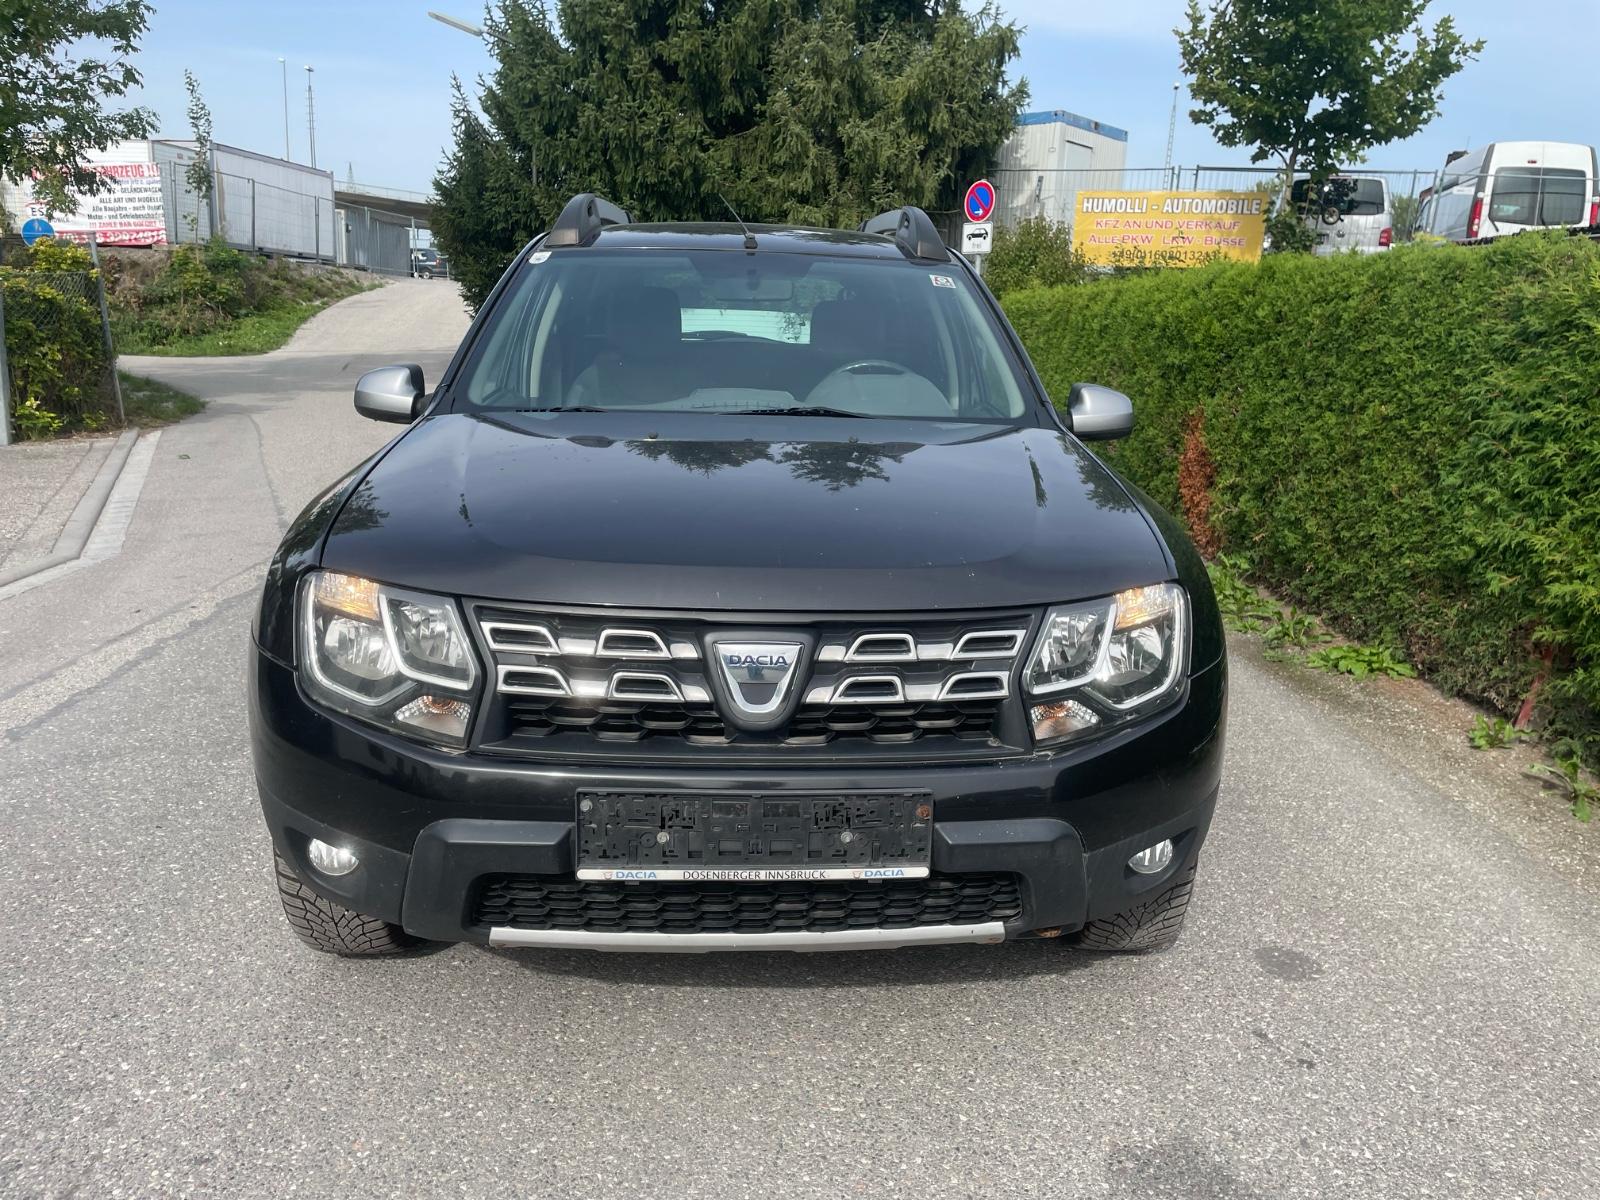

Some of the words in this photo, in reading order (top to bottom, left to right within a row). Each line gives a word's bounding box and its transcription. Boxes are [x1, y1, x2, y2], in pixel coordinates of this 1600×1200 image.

[1082, 197, 1147, 214] HUMOLLI
[1162, 198, 1262, 216] AUTOMOBILE
[1095, 219, 1120, 229] KFZ
[1122, 219, 1142, 229] AN
[1145, 219, 1173, 229] UND
[1177, 220, 1241, 230] VERKAUF
[1122, 234, 1153, 244] PKW
[1162, 235, 1195, 245] LKW
[1204, 236, 1246, 247] BUSSE
[729, 655, 789, 666] DACIA
[615, 871, 657, 880] DACIA
[683, 871, 761, 880] DOSENBERGER
[765, 870, 826, 880] INNSBRUCK
[864, 868, 905, 878] DACIA
